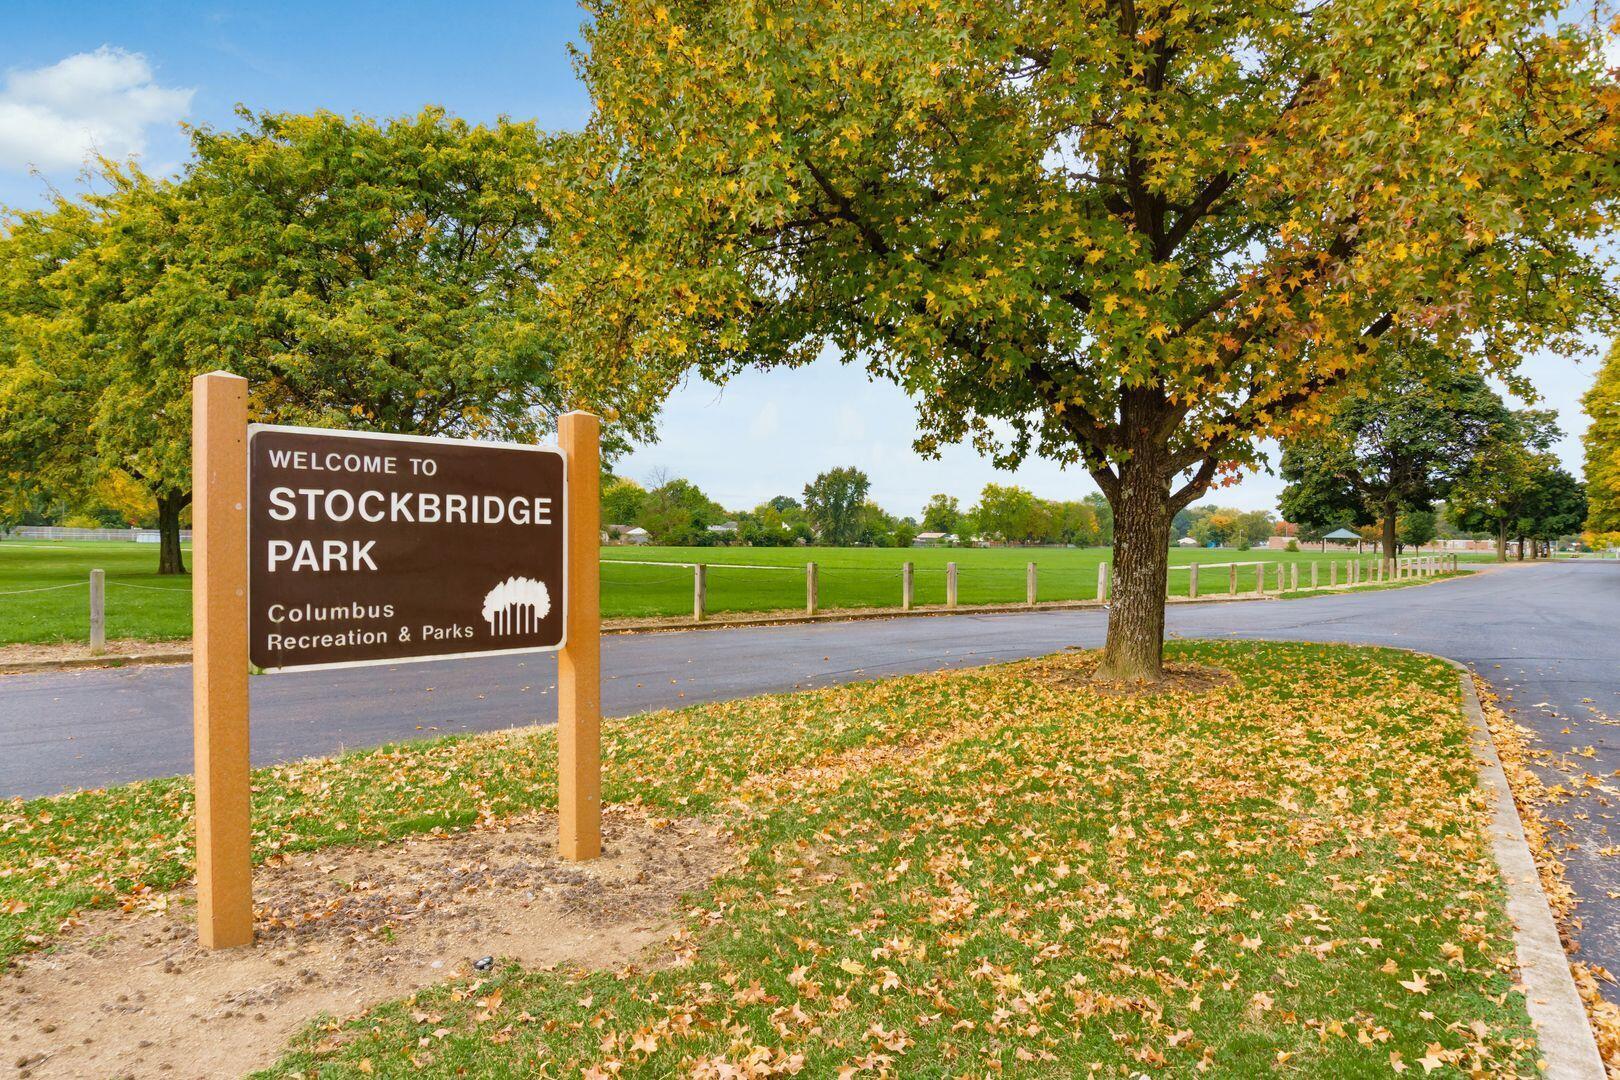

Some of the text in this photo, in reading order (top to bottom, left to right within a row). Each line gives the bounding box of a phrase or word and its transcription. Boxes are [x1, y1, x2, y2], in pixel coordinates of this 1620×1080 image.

[269, 450, 437, 476] WELCOME TO
[269, 487, 551, 525] STOCKBRIDGE
[268, 540, 378, 572] PARK
[268, 602, 394, 623] Columbus
[268, 624, 473, 650] Recreation & Parks
